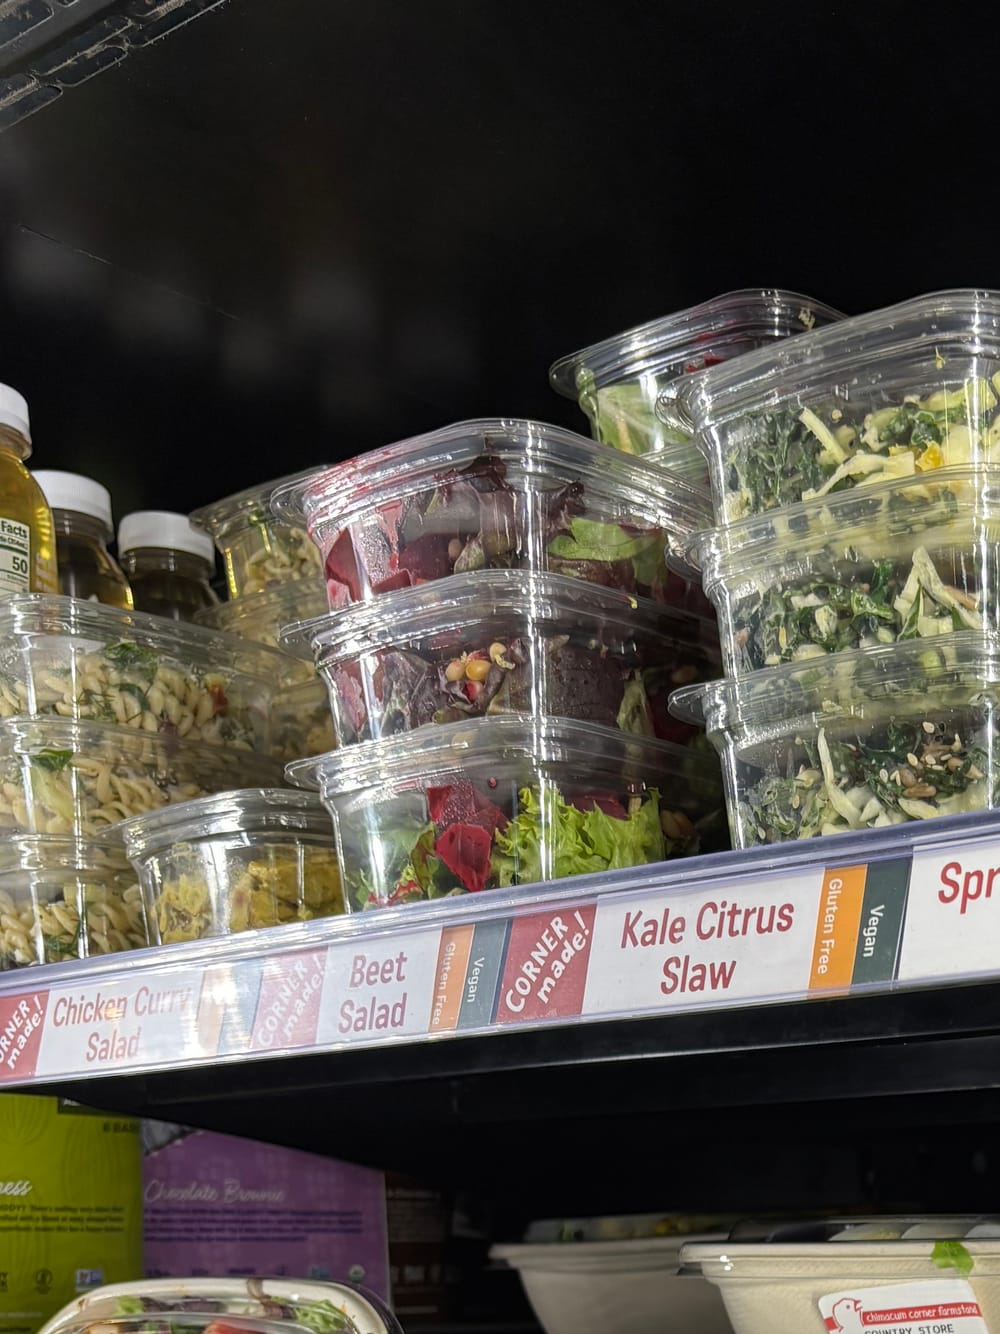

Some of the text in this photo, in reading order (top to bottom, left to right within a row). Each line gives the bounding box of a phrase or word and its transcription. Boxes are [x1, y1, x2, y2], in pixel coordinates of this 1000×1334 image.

[12, 556, 28, 574] 50
[621, 900, 794, 949] Kale Citrus
[817, 877, 843, 975] Gluten Free
[863, 904, 885, 958] Vegan
[350, 952, 408, 988] Beet
[466, 956, 485, 1003] Vegan
[505, 916, 569, 1013] CORNER
[536, 910, 590, 1004] made!
[660, 955, 737, 995] Slaw
[53, 986, 192, 1028] Chicken Curry
[257, 960, 308, 1046] CORNER
[283, 953, 326, 1040] made!
[432, 941, 456, 1026] Gluten Free
[7, 995, 44, 1070] made!
[338, 992, 407, 1034] Salad
[86, 1026, 142, 1062] Salad
[866, 1303, 979, 1323] chimacum corner farmstand
[919, 1323, 955, 1334] STORE
